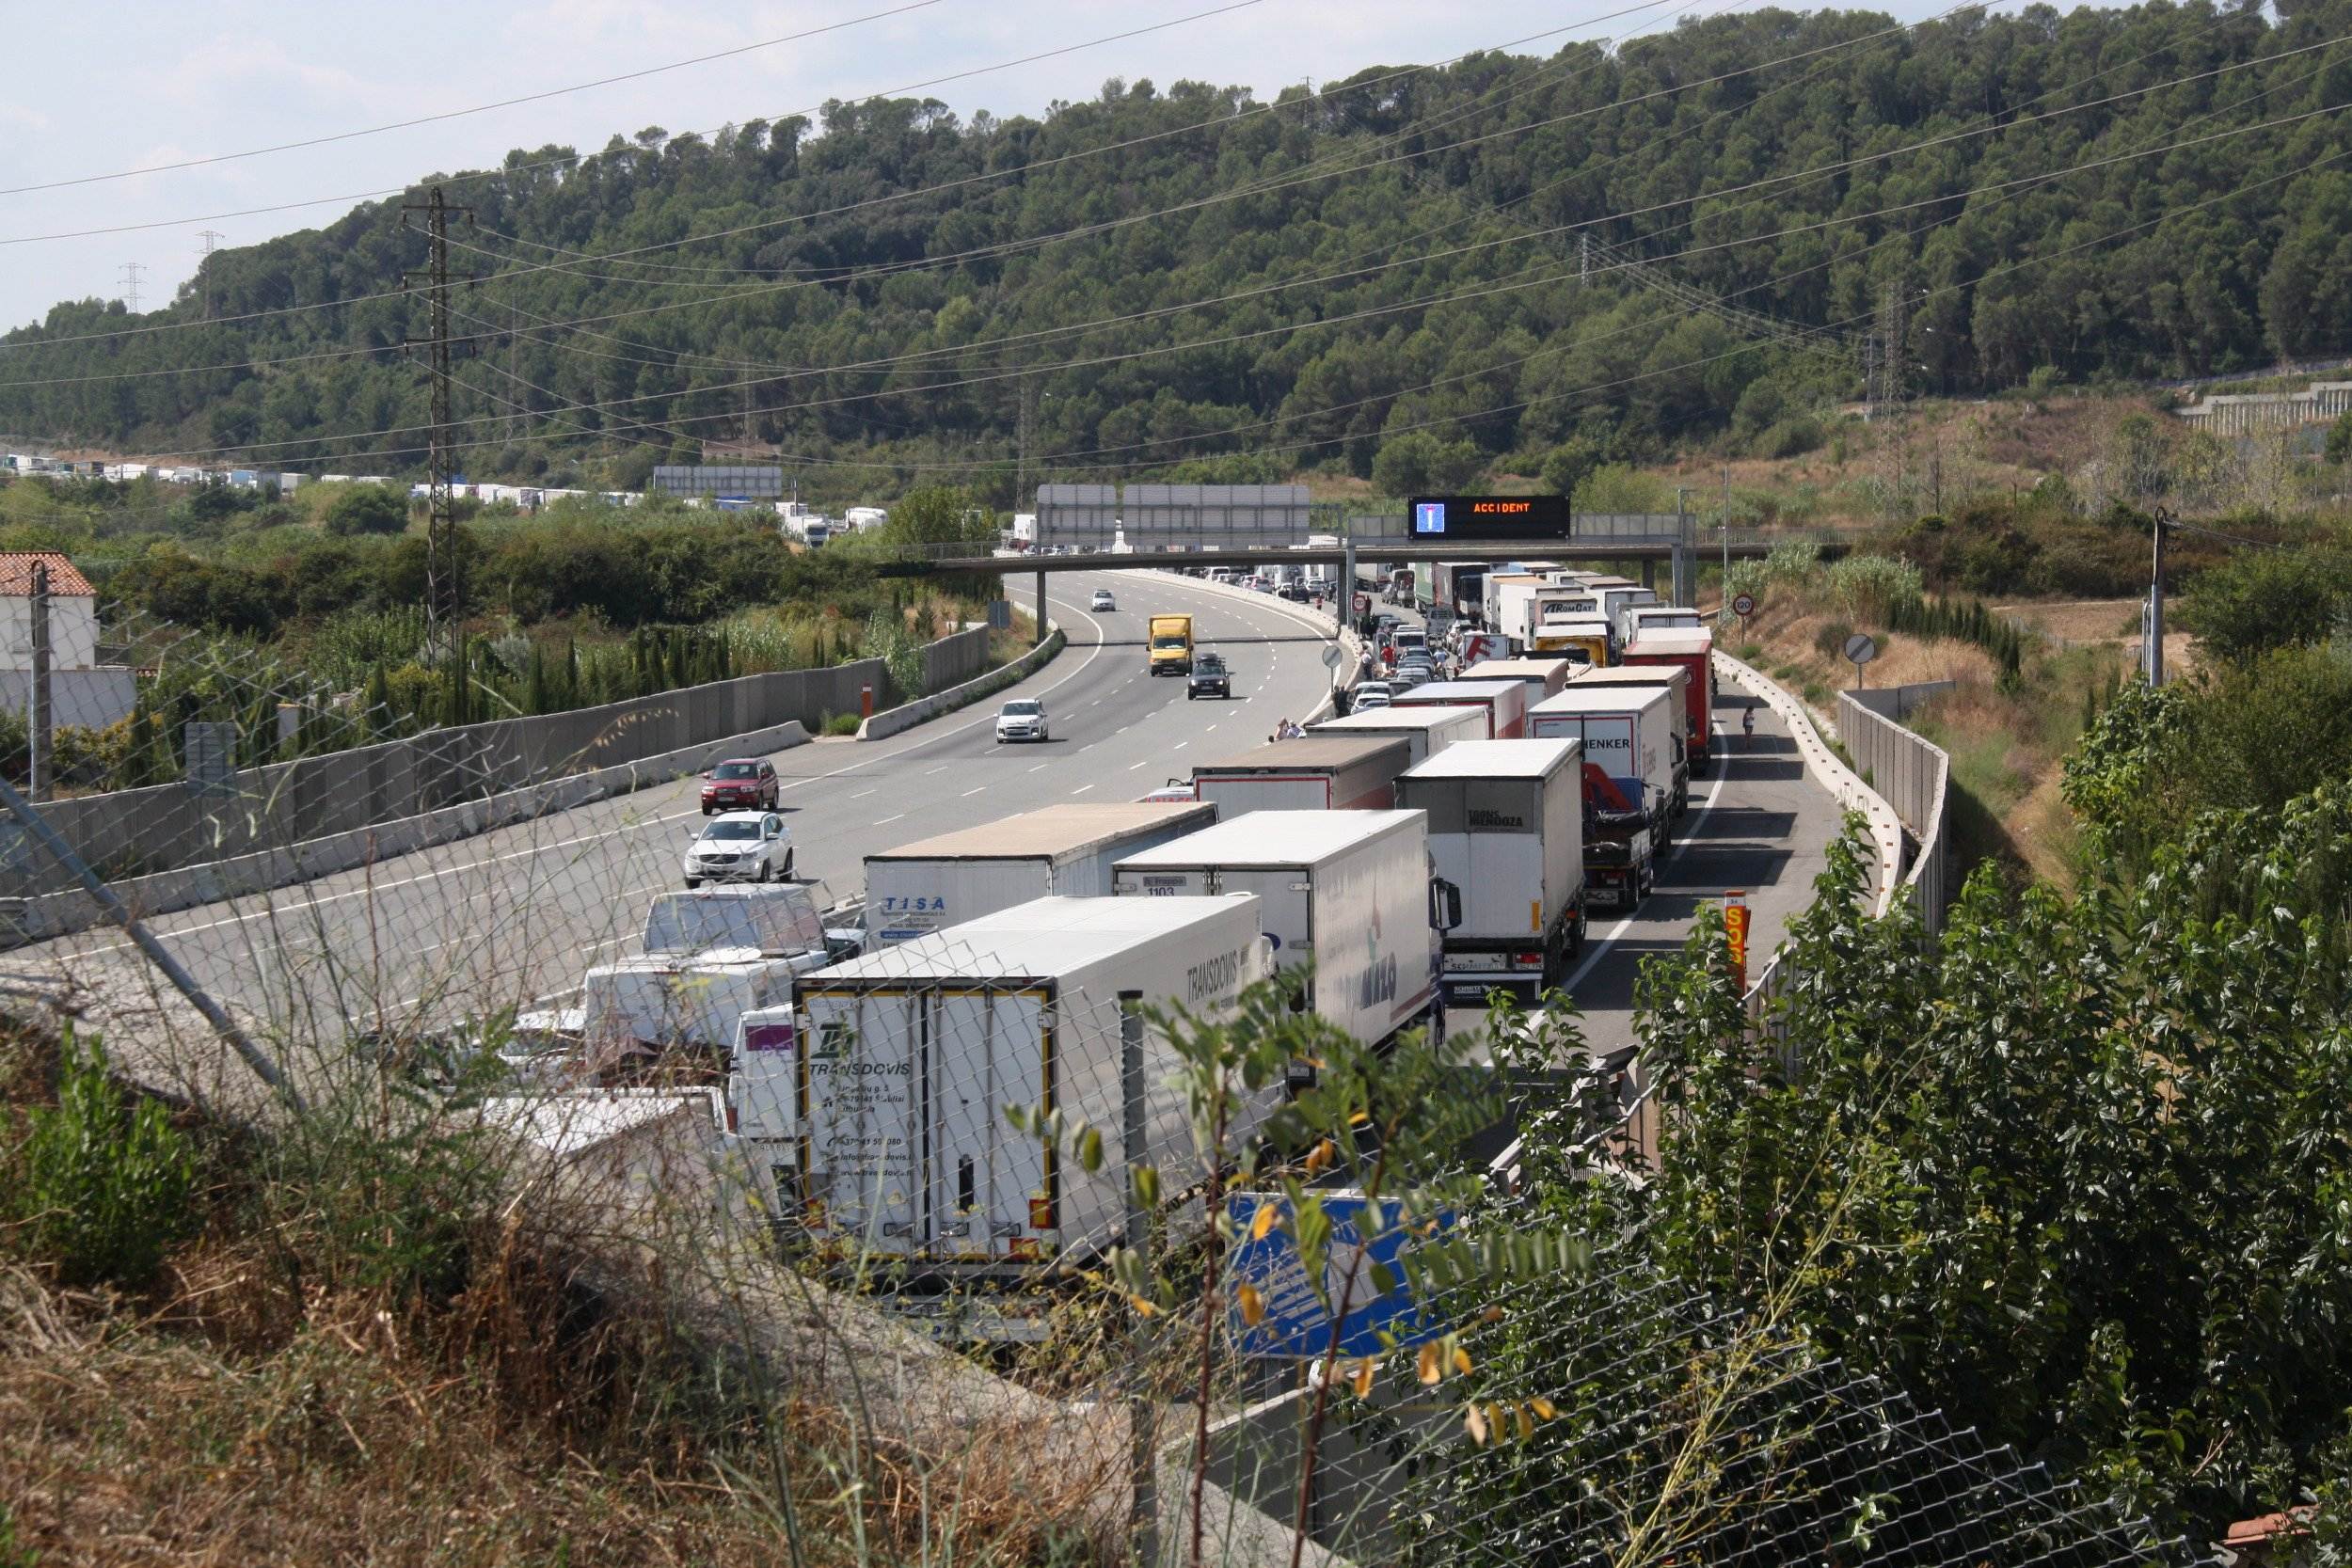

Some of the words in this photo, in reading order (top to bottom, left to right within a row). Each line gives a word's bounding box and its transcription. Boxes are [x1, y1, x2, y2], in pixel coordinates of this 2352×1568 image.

[1473, 503, 1531, 513] ACCIDENT
[1727, 908, 1742, 964] SOS
[1187, 948, 1237, 1005] TRANSDOVIS
[810, 1063, 912, 1075] TRANSDOVIS
